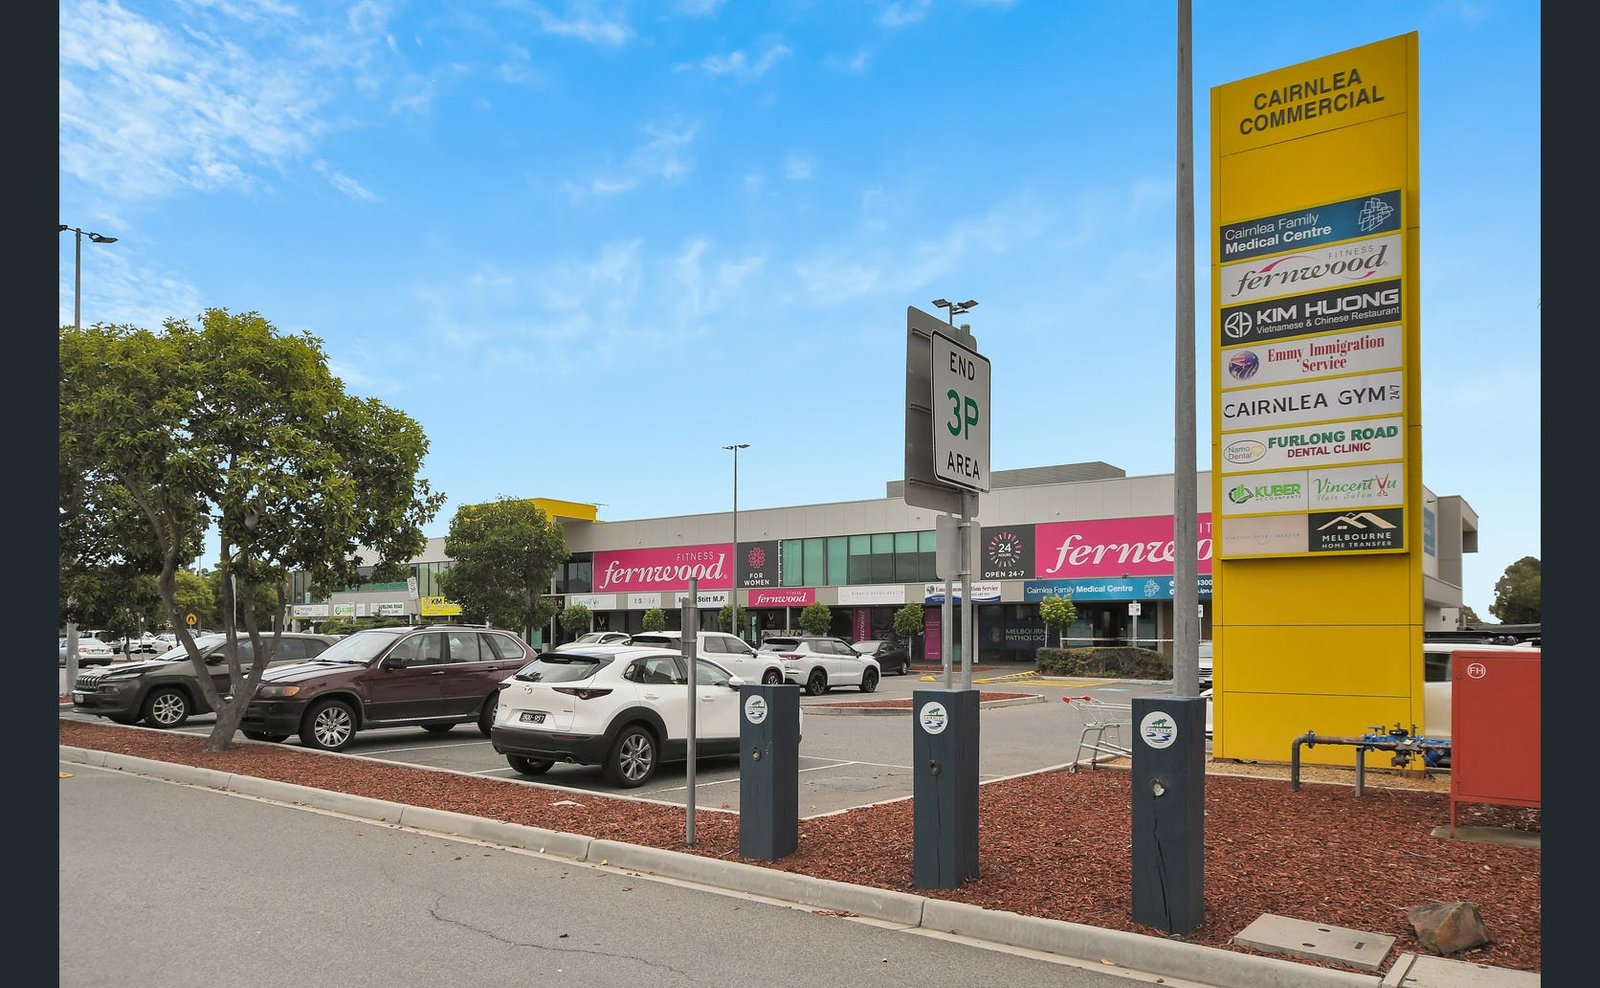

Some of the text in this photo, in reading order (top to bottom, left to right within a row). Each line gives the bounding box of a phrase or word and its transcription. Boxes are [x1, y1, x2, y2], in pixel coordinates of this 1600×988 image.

[1254, 68, 1362, 110] CAIRNLEA
[1240, 85, 1385, 135] COMMERCIAL
[1225, 213, 1319, 241] Cairnlea Family
[1225, 225, 1332, 254] Medical Centre
[1328, 245, 1375, 260] FITNESS
[1231, 245, 1388, 297] fernwood
[1257, 289, 1399, 324] KIM HUONG
[1257, 306, 1400, 334] Vietnamese & Chinese Restaurant
[1268, 335, 1385, 363] Emmy Immigration
[950, 351, 975, 381] END
[1302, 355, 1347, 373] Service
[1223, 386, 1386, 418] CAIRNLEA GYM
[947, 389, 979, 441] 3P
[1268, 425, 1399, 449] FURLONG ROAD
[1228, 452, 1253, 461] Dental
[1287, 441, 1371, 458] DENTAL CLINIC
[947, 451, 981, 481] AREA
[1254, 483, 1302, 497] KUBER
[1314, 478, 1377, 494] Vincent
[1322, 532, 1391, 542] MELBOURNE
[1348, 541, 1392, 549] TRANSFER
[676, 551, 714, 562] FITNESS
[998, 543, 1012, 553] 24
[599, 553, 726, 590] fernwood
[743, 579, 770, 587] WOMEN
[1026, 584, 1133, 595] Cairnlea Family Medical Centre
[755, 592, 807, 605] fernwood
[1469, 667, 1484, 675] FH
